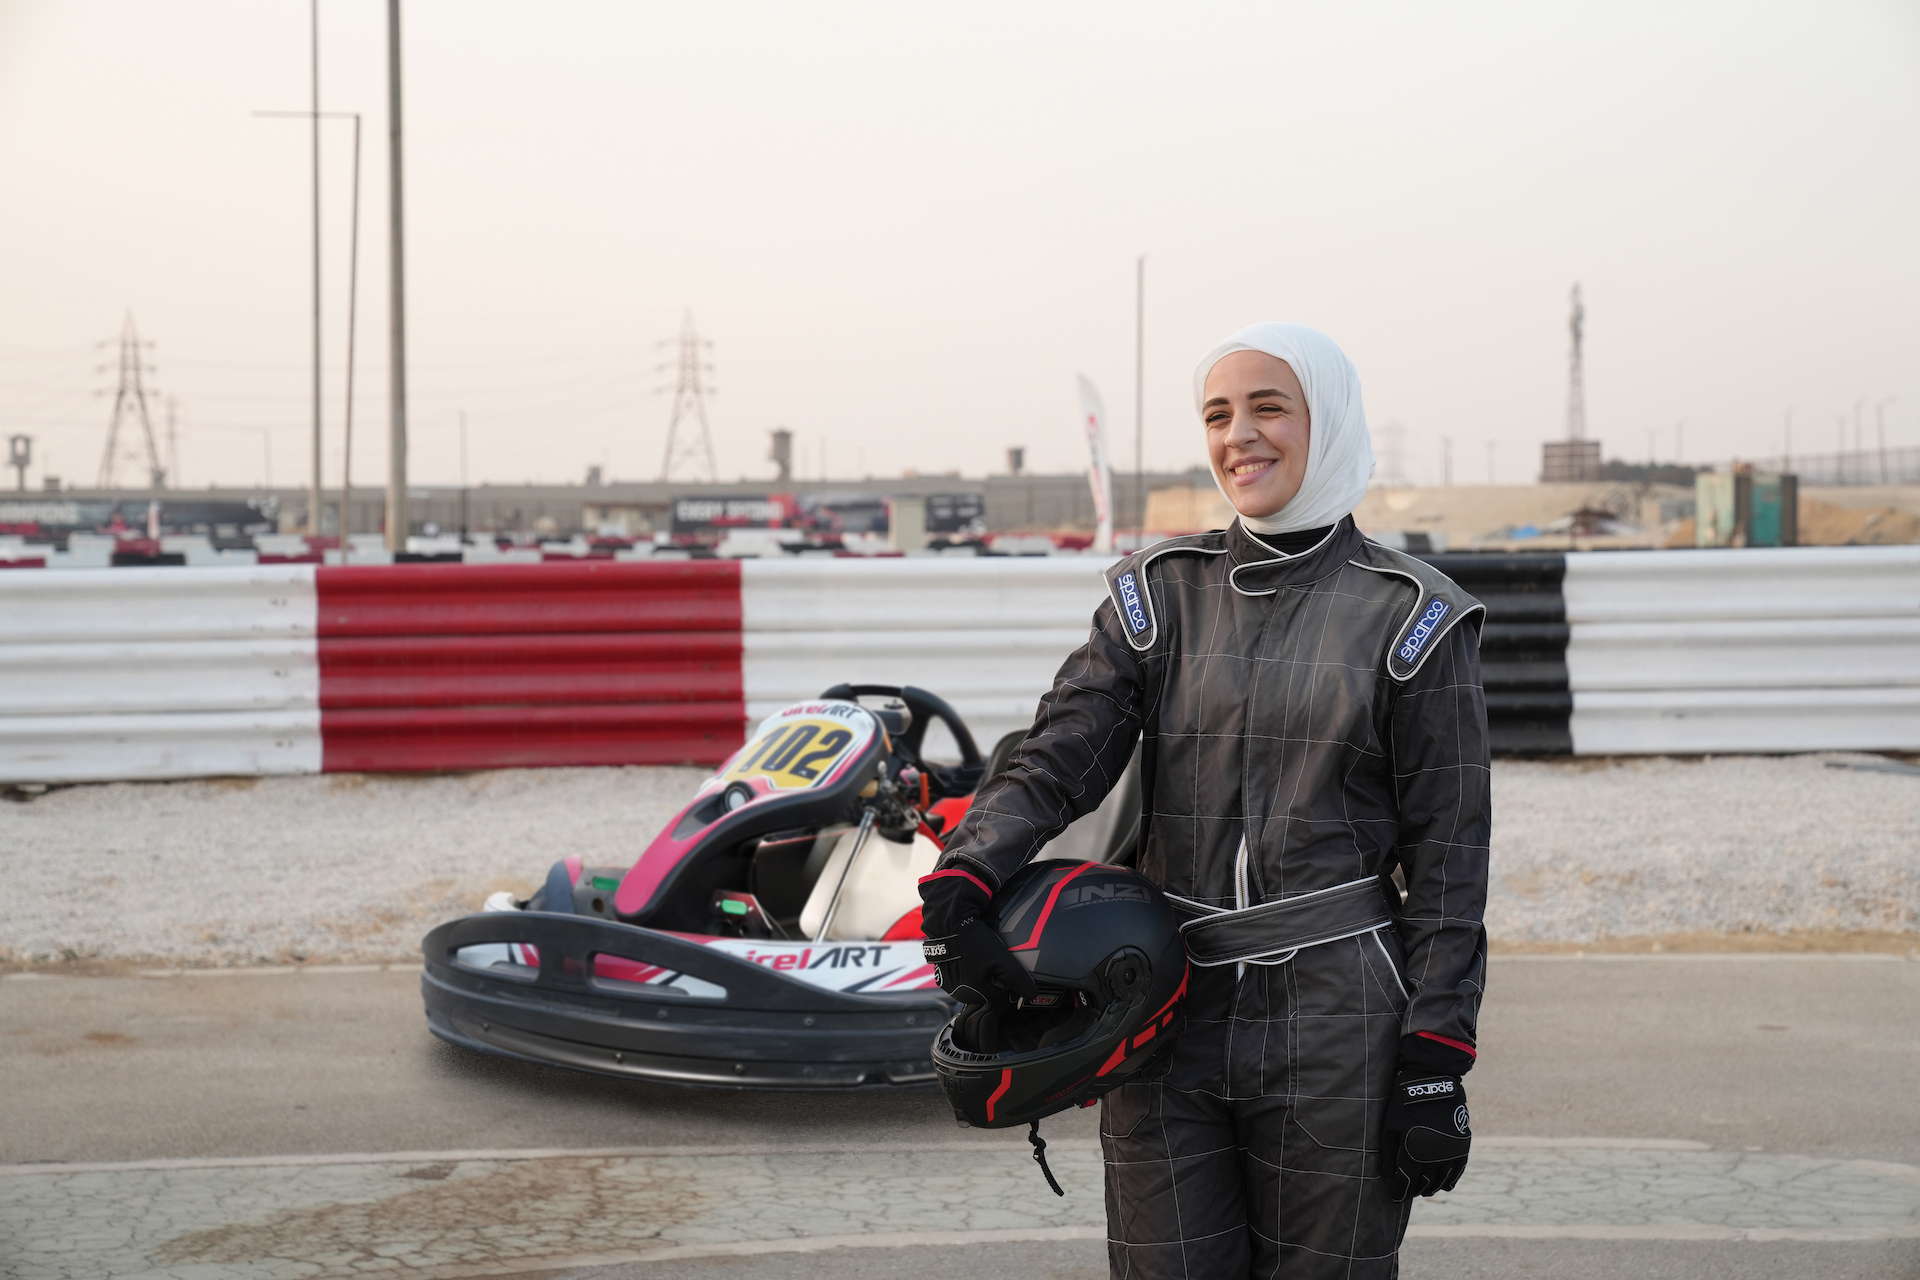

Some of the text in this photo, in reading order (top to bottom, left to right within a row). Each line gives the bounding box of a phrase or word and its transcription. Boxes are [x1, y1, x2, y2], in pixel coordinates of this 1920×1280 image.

[1119, 574, 1146, 634] sparco
[1400, 601, 1449, 662] sparco
[737, 725, 853, 778] 102
[1407, 1081, 1454, 1096] sparco
